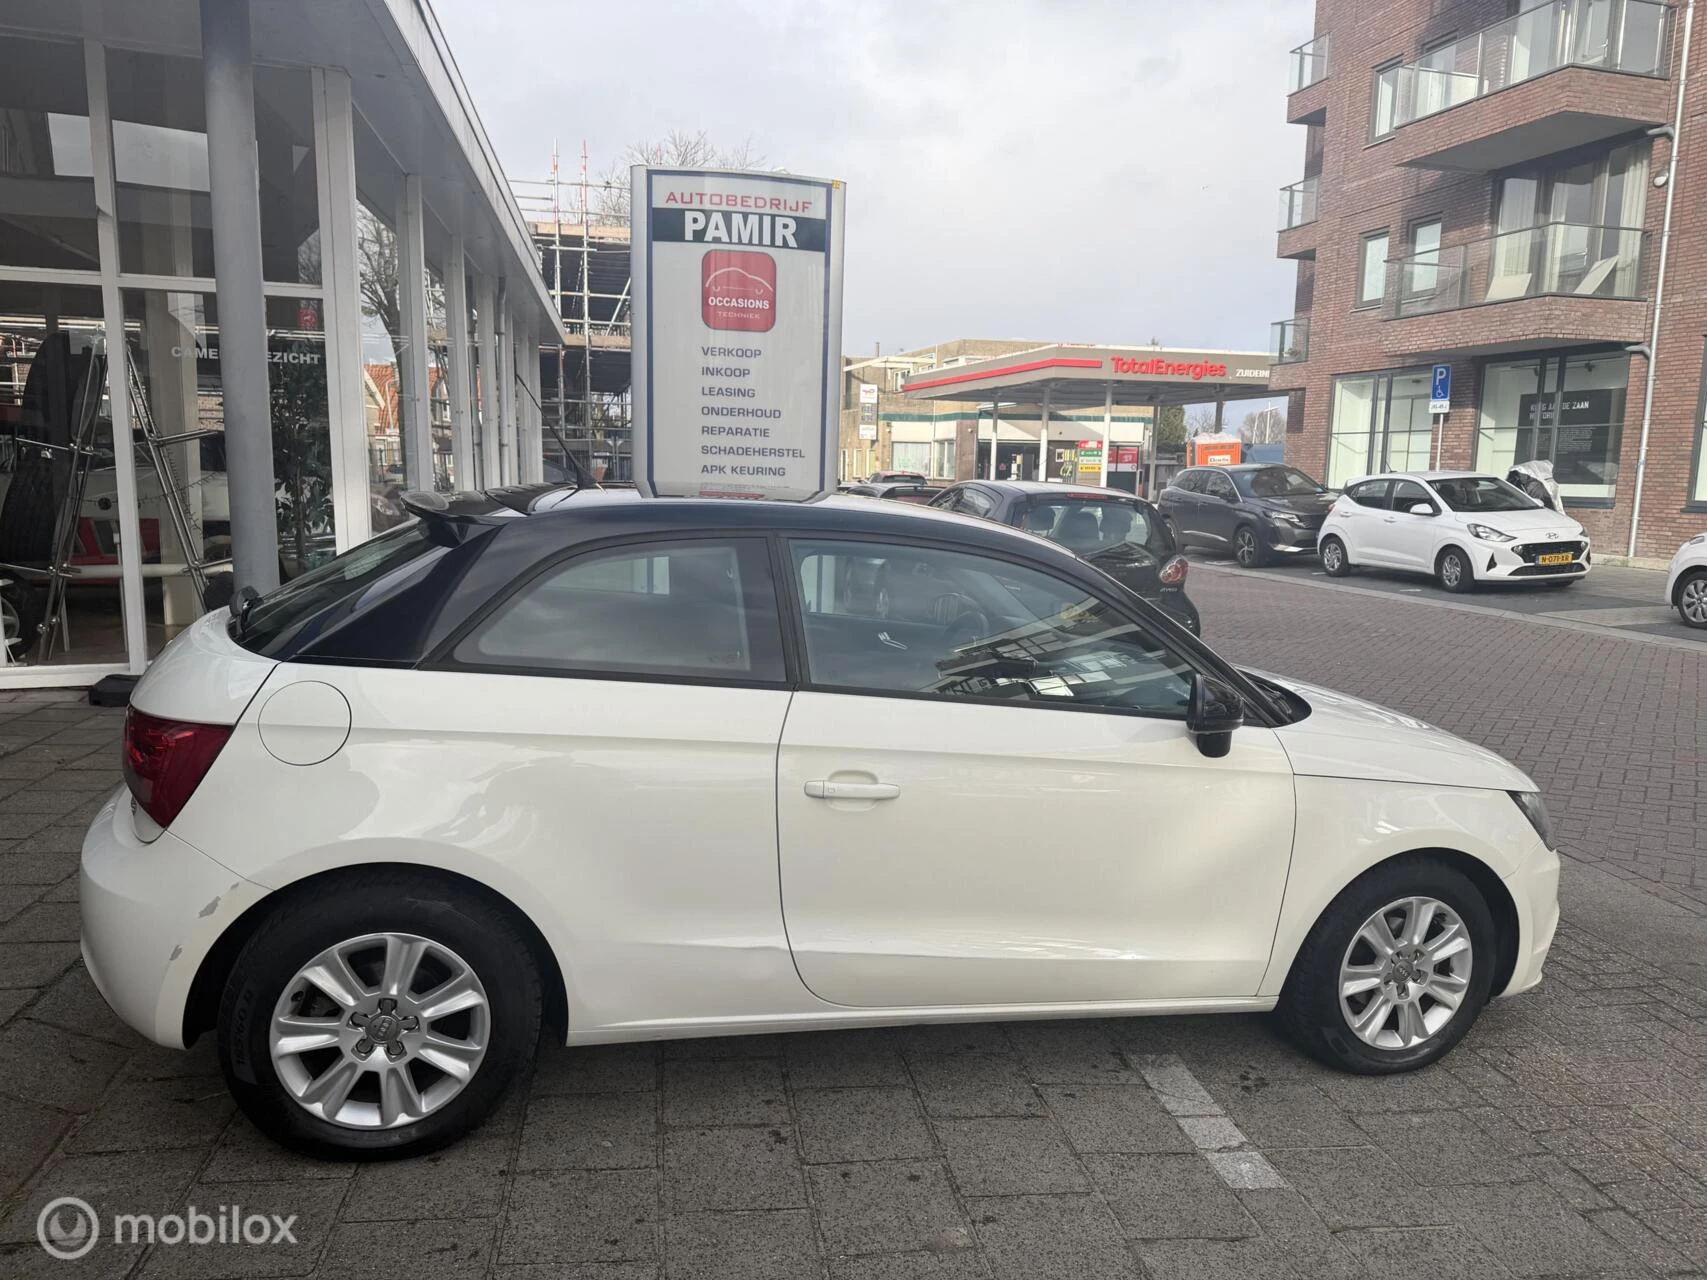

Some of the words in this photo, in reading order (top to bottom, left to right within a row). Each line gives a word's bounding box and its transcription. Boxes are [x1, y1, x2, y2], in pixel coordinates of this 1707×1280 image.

[665, 192, 813, 212] AUTOBEDRIJF
[684, 210, 798, 248] PAMIR
[708, 296, 770, 309] OCCASIONS
[701, 346, 762, 358] VERKOOP
[701, 366, 751, 377] INKOOP
[1111, 356, 1226, 380] TotalEnergies
[1436, 367, 1447, 385] P
[701, 386, 756, 398] LEASING
[1572, 401, 1590, 409] ZAAN
[701, 406, 782, 419] ONDERHOUD
[701, 425, 771, 438] REPARATIE
[701, 445, 806, 459] SCHADEHERSTEL
[701, 464, 727, 475] APK
[731, 465, 786, 477] KEURING
